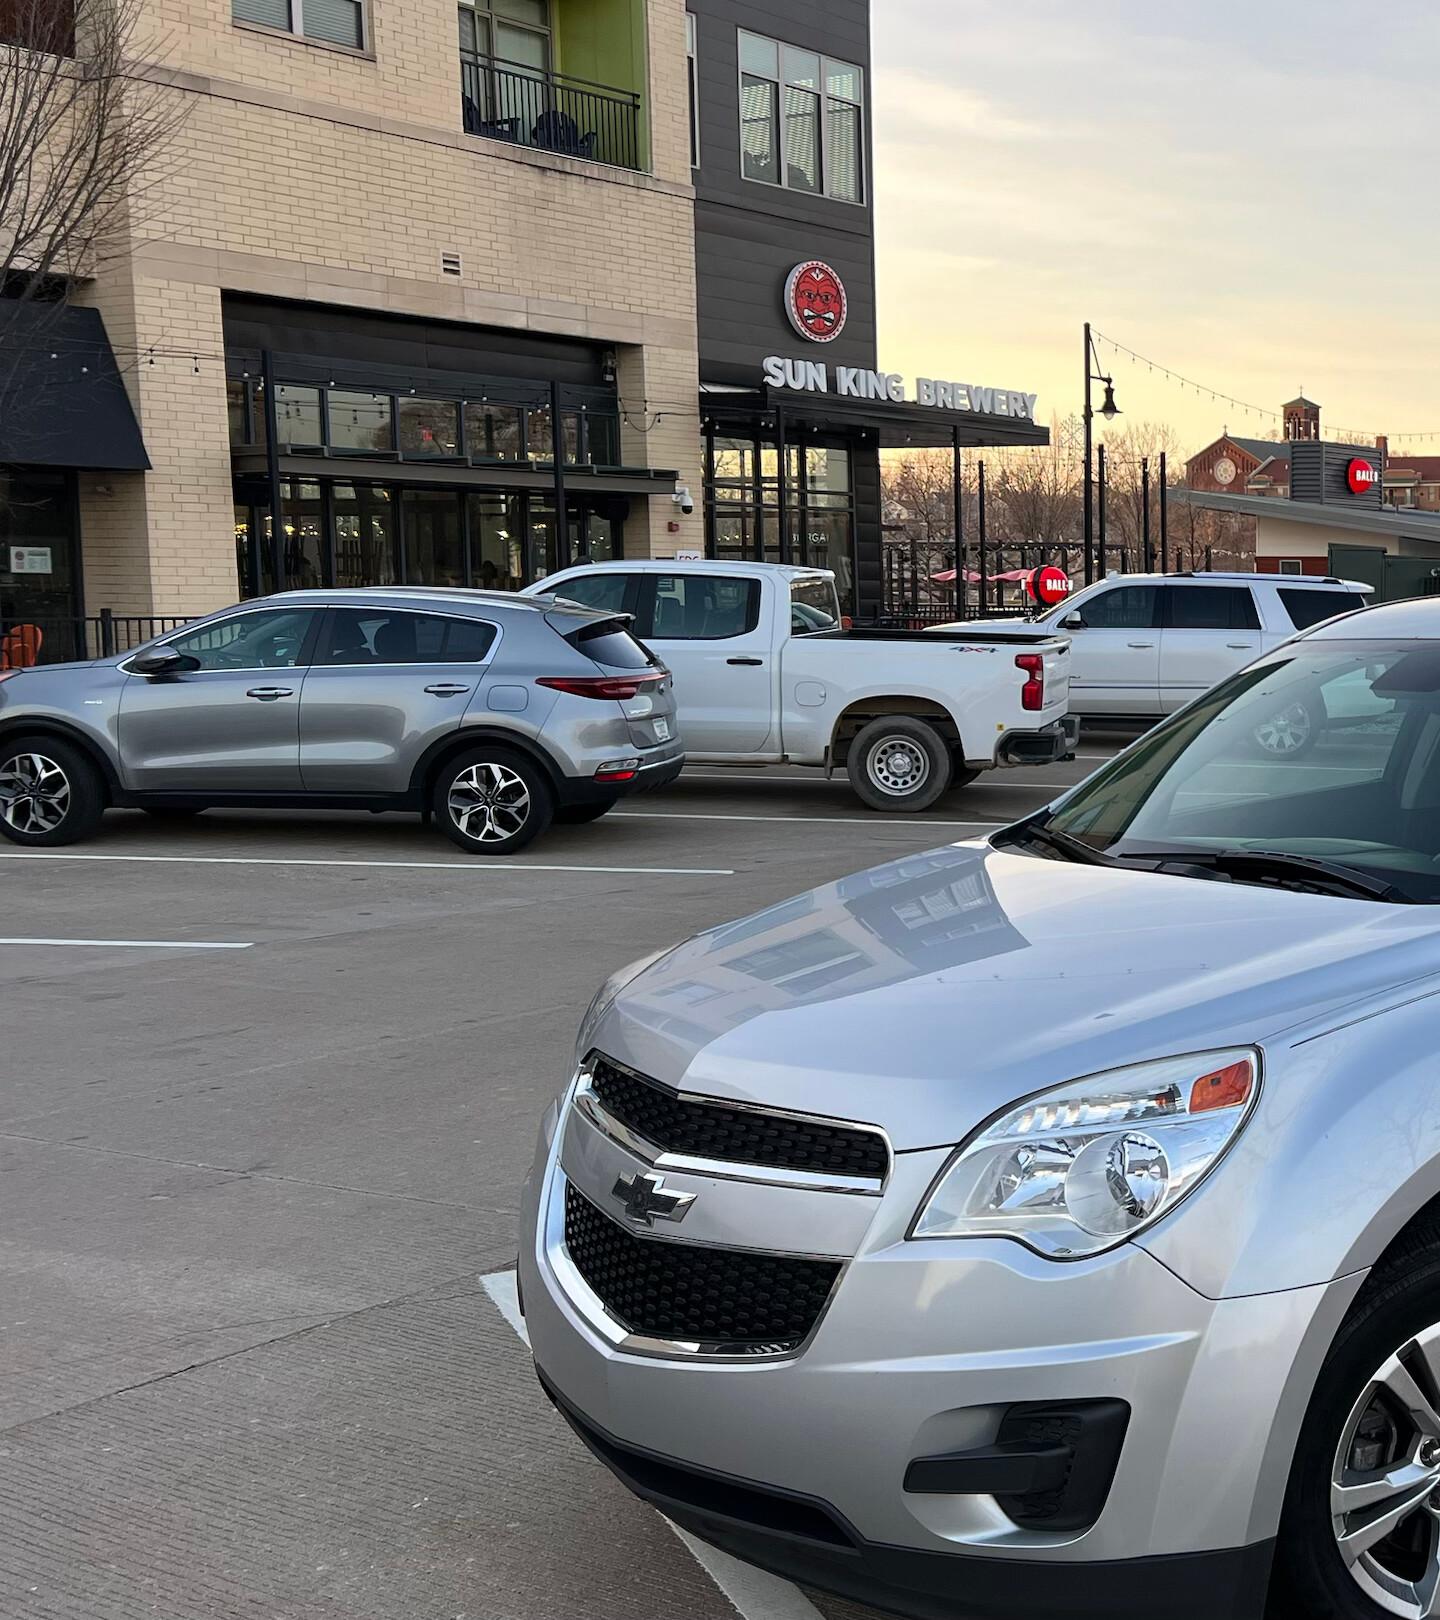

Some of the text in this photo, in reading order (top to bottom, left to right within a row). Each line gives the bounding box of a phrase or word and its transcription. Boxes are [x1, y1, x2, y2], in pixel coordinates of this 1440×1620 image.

[763, 356, 1037, 419] SUN KING BREWERY
